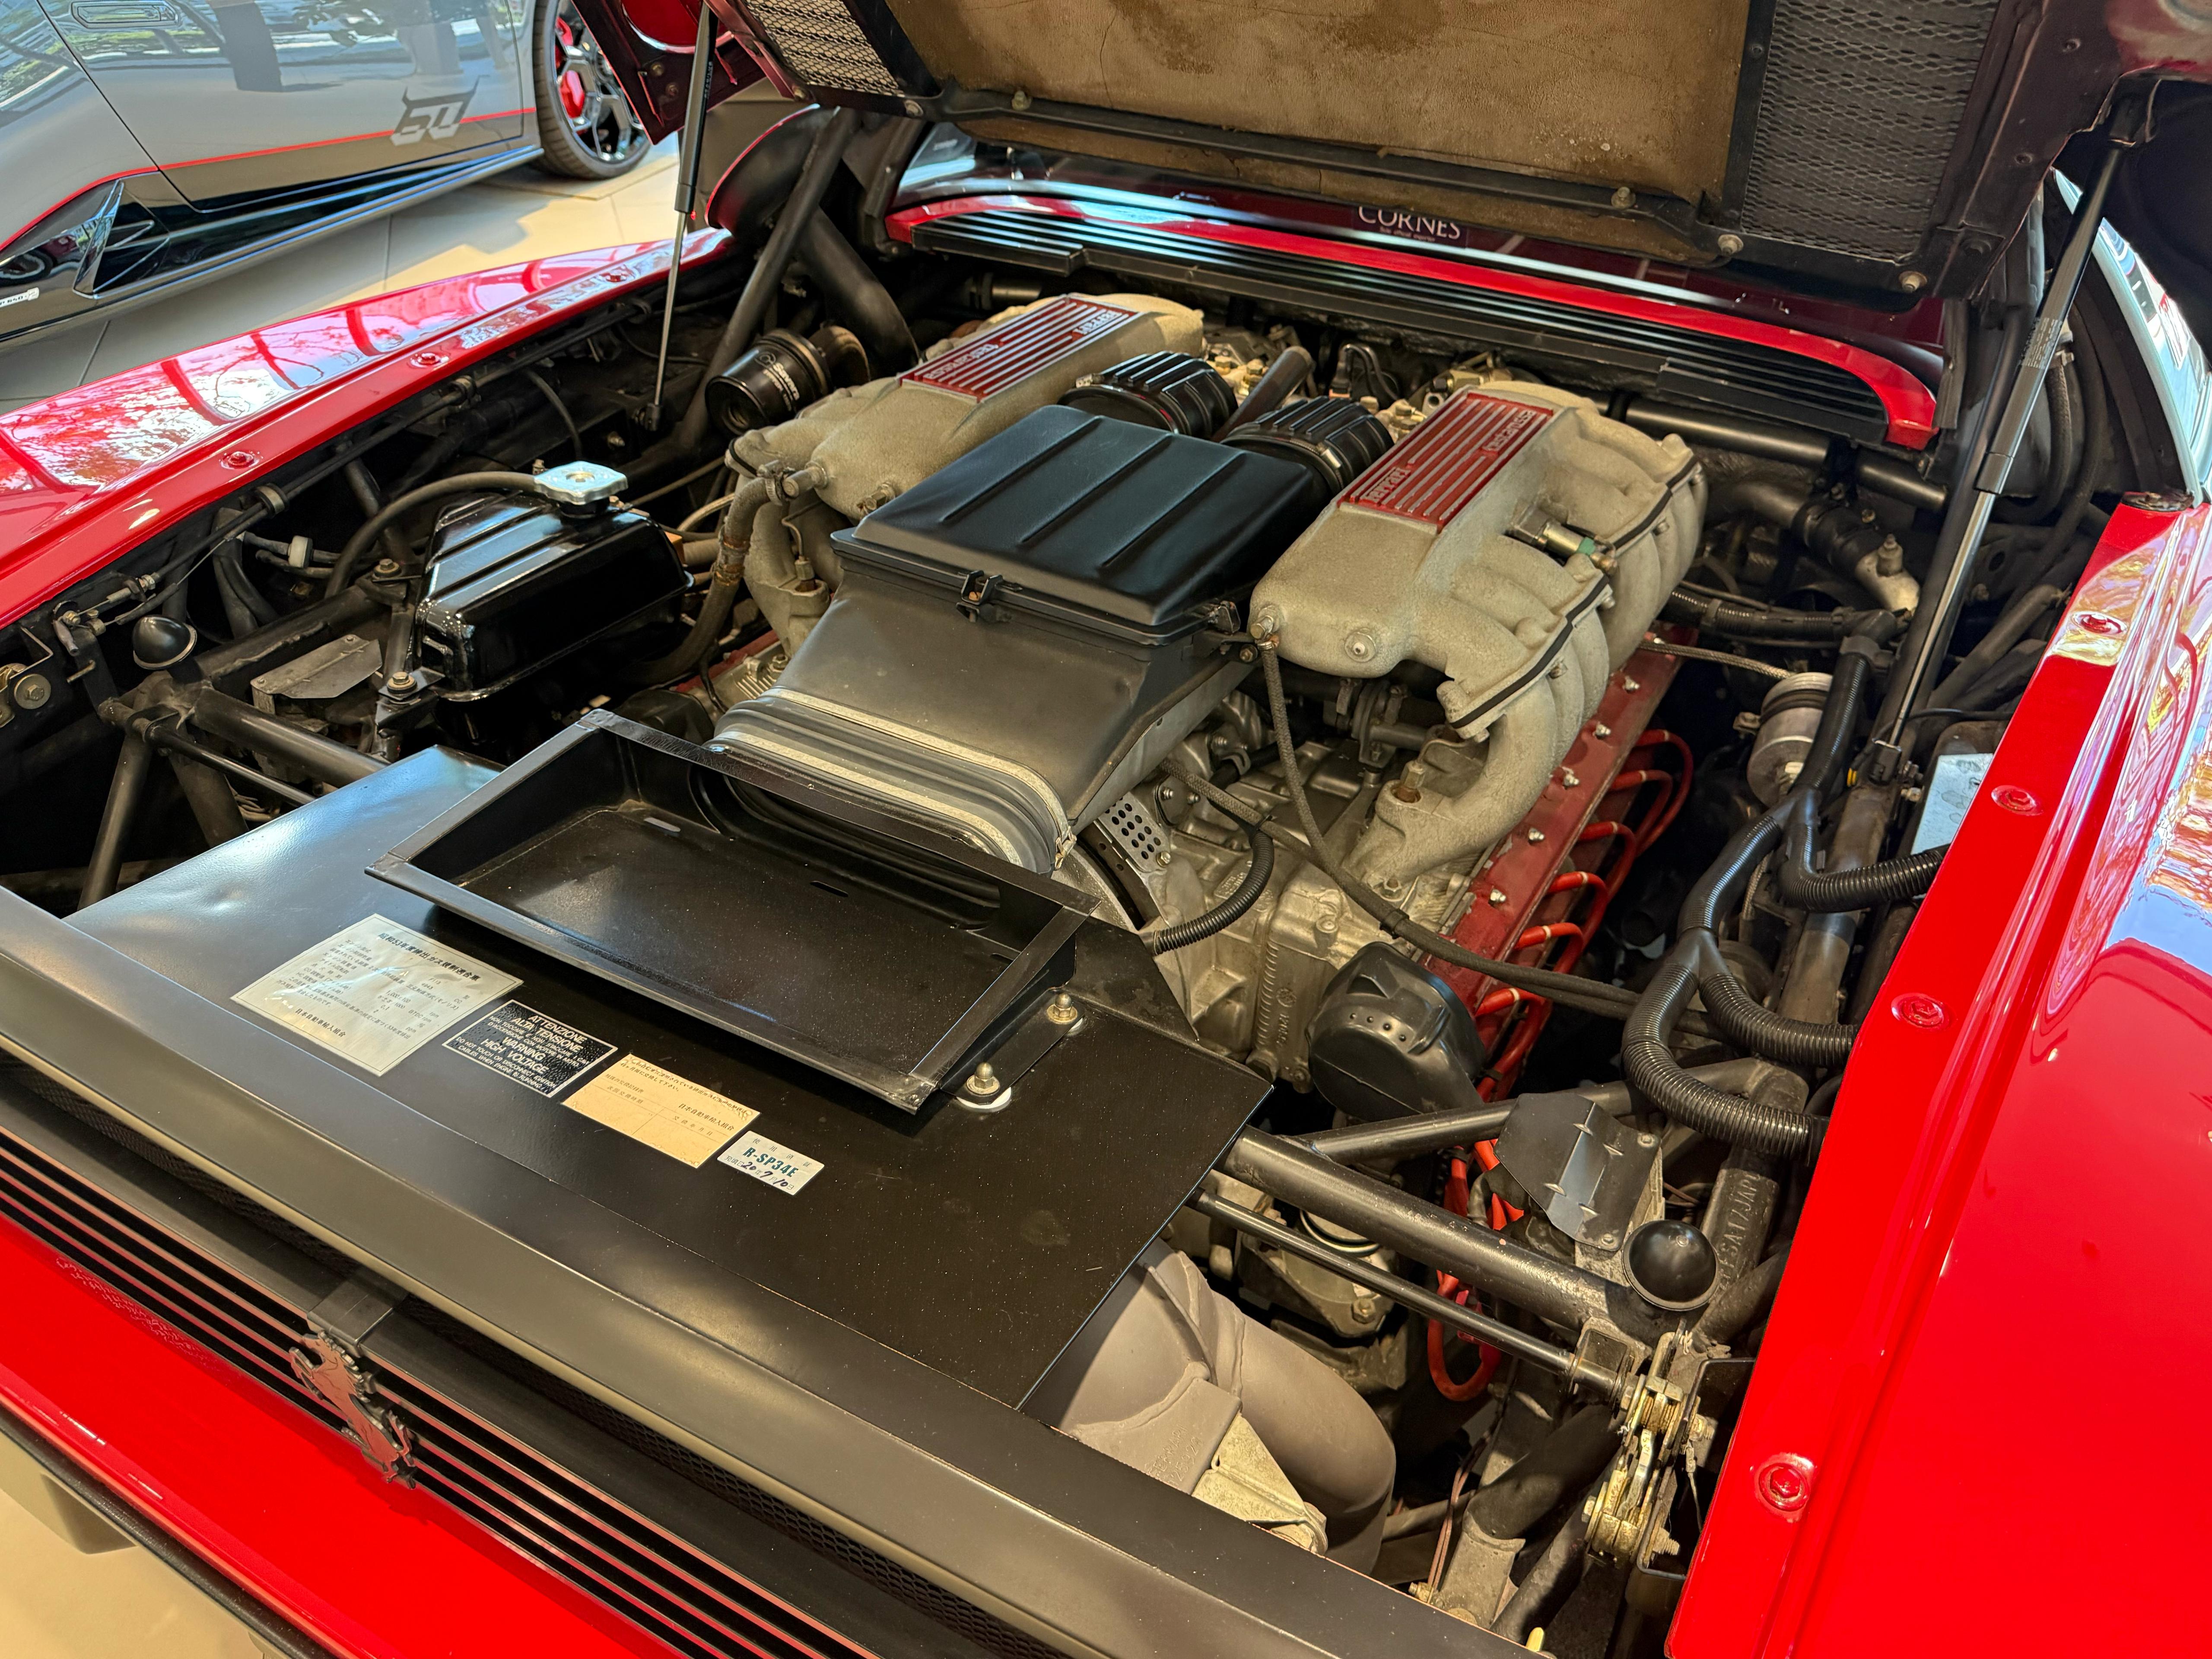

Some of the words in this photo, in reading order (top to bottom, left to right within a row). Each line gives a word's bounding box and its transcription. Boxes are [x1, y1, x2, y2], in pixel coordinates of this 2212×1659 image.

[1358, 206, 1461, 239] CORNES
[510, 1016, 537, 1030] ALTA
[534, 1028, 584, 1052] TENSIONE
[527, 1014, 588, 1044] ATTENZIONE
[457, 1045, 479, 1056] CABLES
[477, 1055, 495, 1064] WHEN
[475, 1046, 495, 1057] TOUCH
[501, 1059, 535, 1077] DISCONNECT
[479, 1038, 507, 1053] HIGH
[504, 1050, 550, 1074] VOLTAGE
[499, 1036, 547, 1061] WARNING
[742, 1147, 799, 1177] R-SP34E
